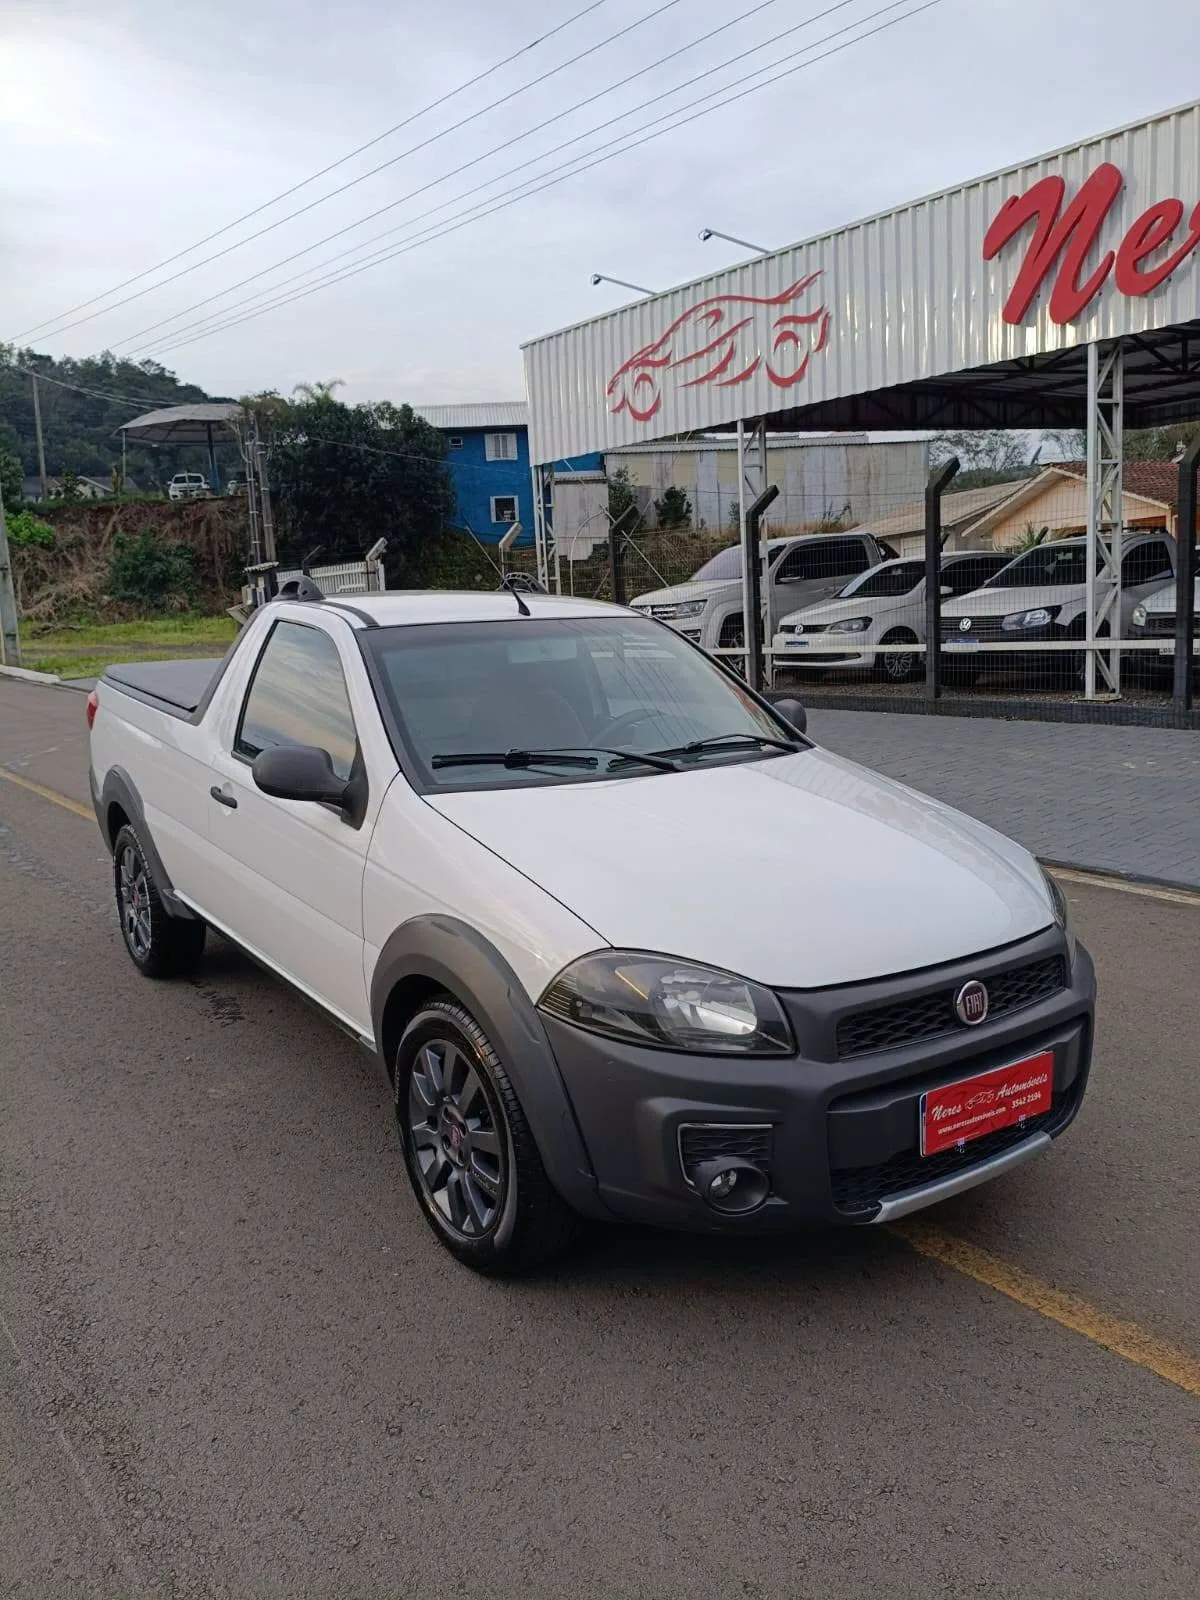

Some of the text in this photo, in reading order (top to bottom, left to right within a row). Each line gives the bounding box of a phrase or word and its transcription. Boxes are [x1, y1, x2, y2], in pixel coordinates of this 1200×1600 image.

[983, 162, 1200, 325] Ne
[965, 991, 983, 1016] FIAT
[931, 1073, 1048, 1121] Neres Automóveis
